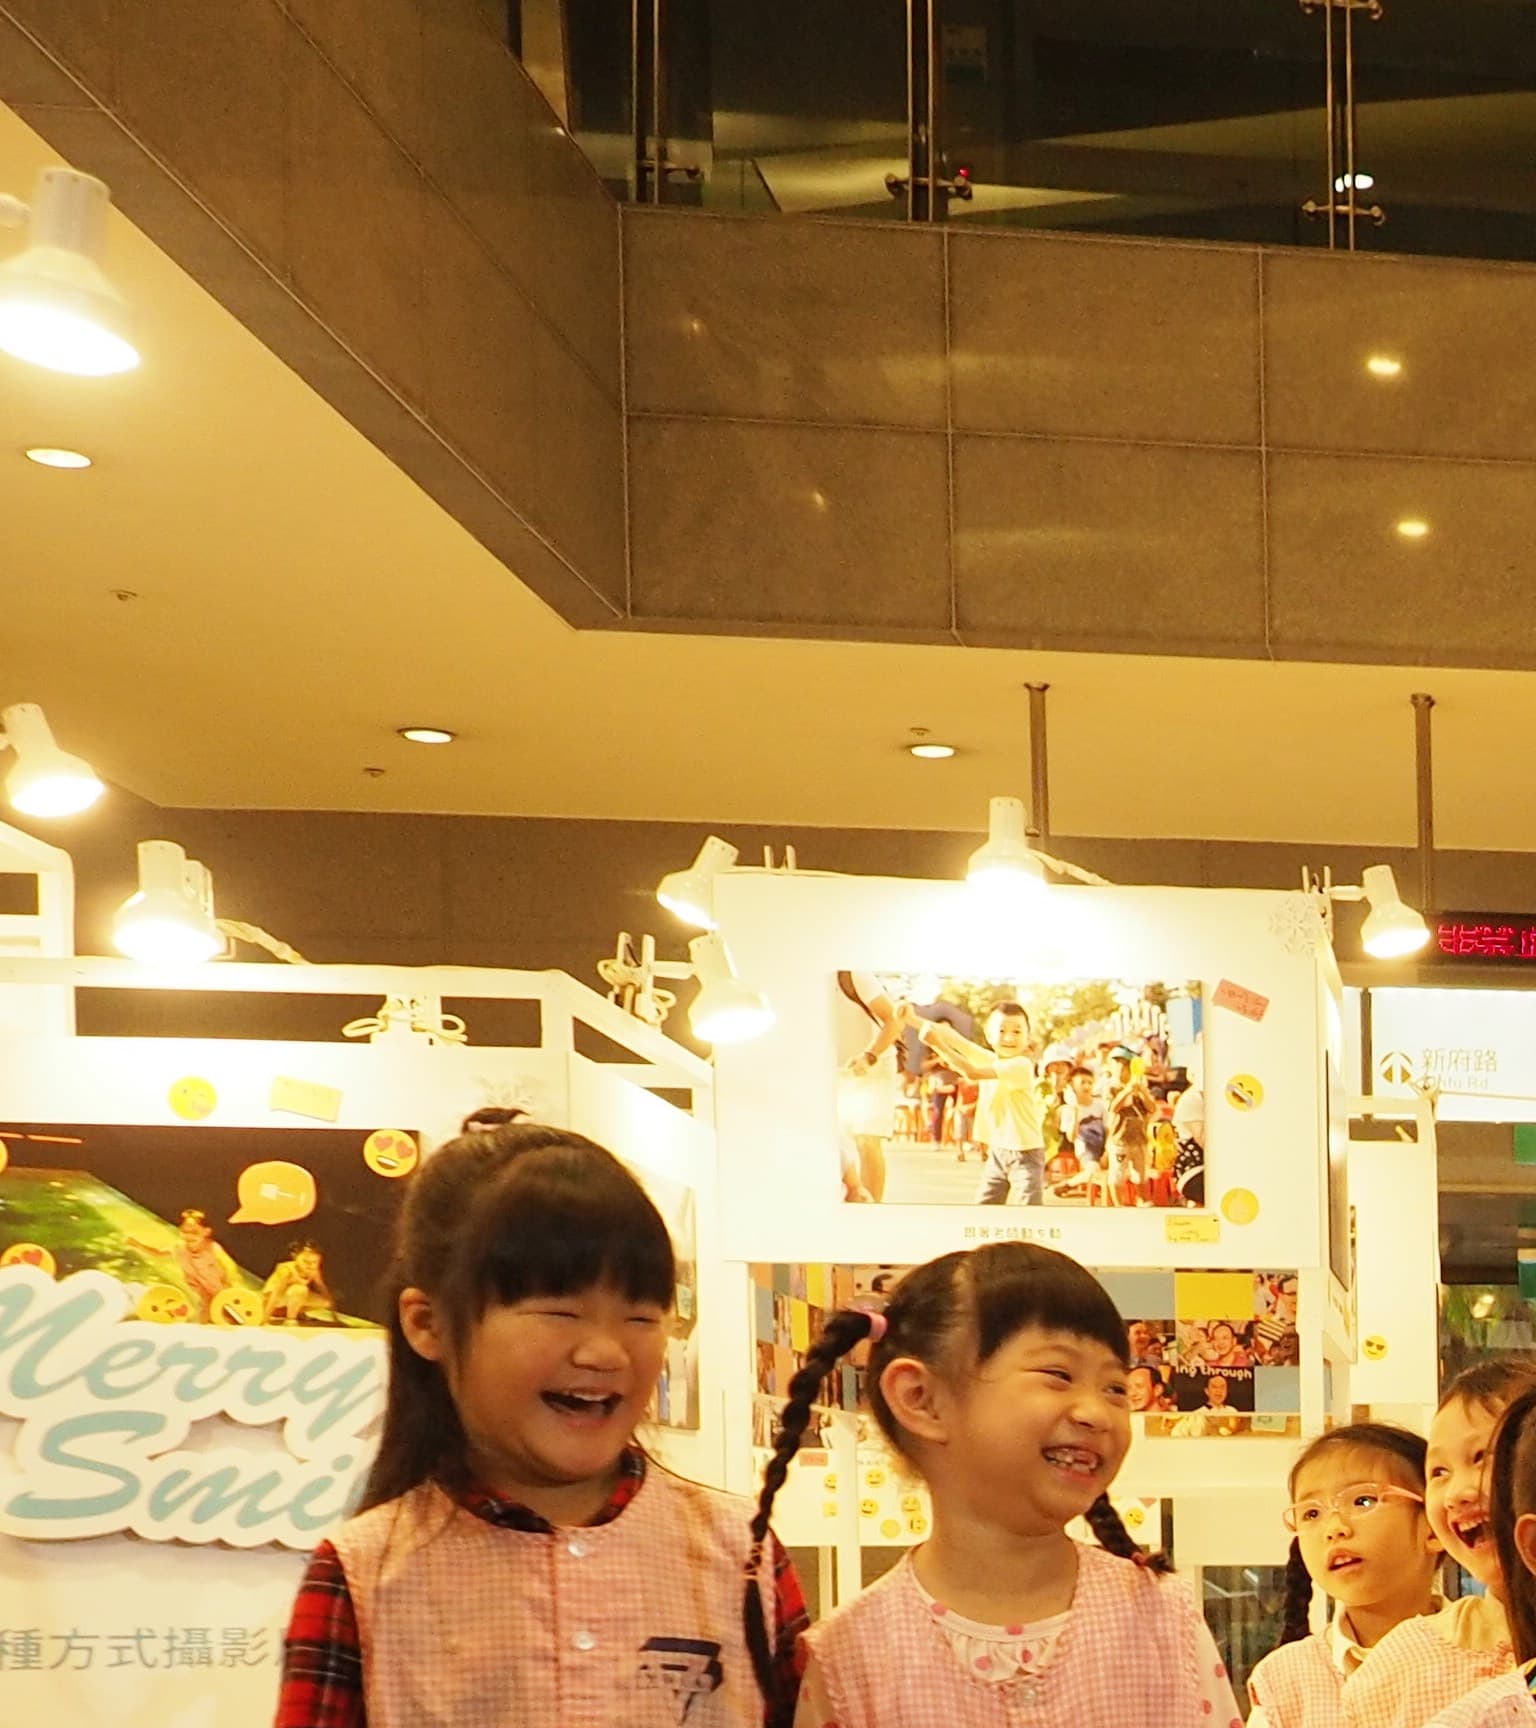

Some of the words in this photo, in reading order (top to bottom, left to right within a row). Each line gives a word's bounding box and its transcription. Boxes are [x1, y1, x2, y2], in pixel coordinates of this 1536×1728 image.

[1422, 1048, 1498, 1073] 新府路
[1200, 1363, 1252, 1381] through
[5, 1410, 356, 1531] Smi
[0, 1626, 284, 1671] 種方式攝影
